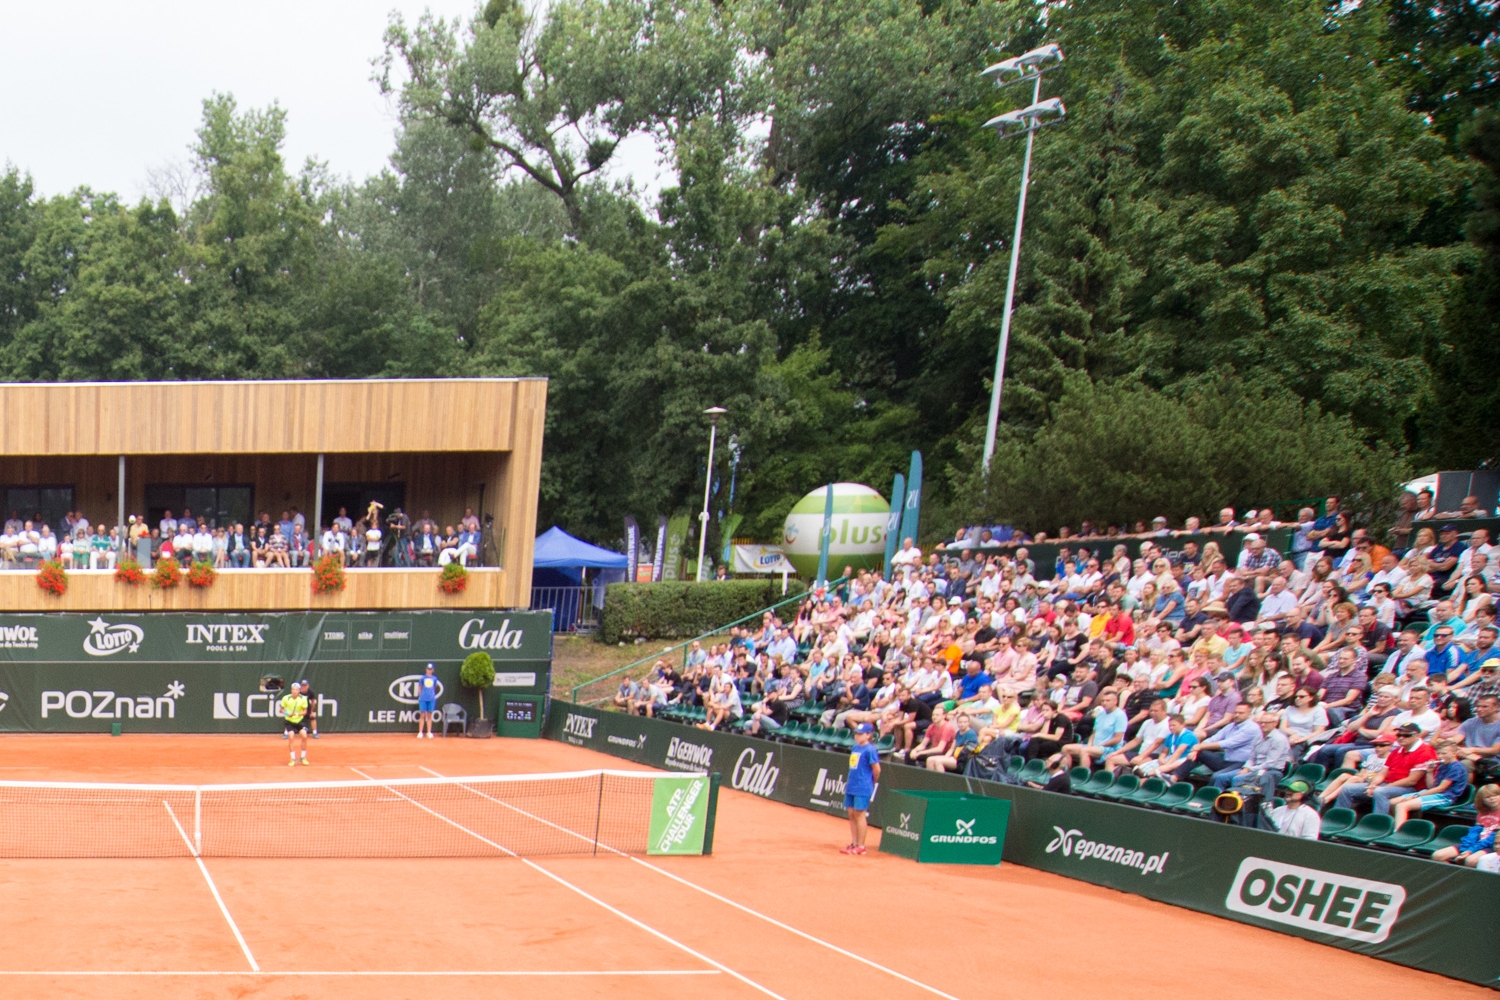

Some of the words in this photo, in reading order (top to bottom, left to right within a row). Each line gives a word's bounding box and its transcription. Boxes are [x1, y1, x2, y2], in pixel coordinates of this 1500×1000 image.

[96, 630, 133, 650] LOTTO
[458, 618, 523, 650] Gala
[369, 711, 395, 723] LEE
[563, 713, 597, 738] INTEX
[677, 741, 713, 767] GEHWOL
[731, 747, 779, 797] Gala
[661, 780, 704, 852] CHALLENGER
[674, 813, 695, 844] TOUR
[886, 826, 920, 841] GRUNDFOS
[930, 835, 998, 845] GRUNDFOS
[1074, 838, 1169, 875] epoznan.pl
[1240, 868, 1391, 934] OSHEE
